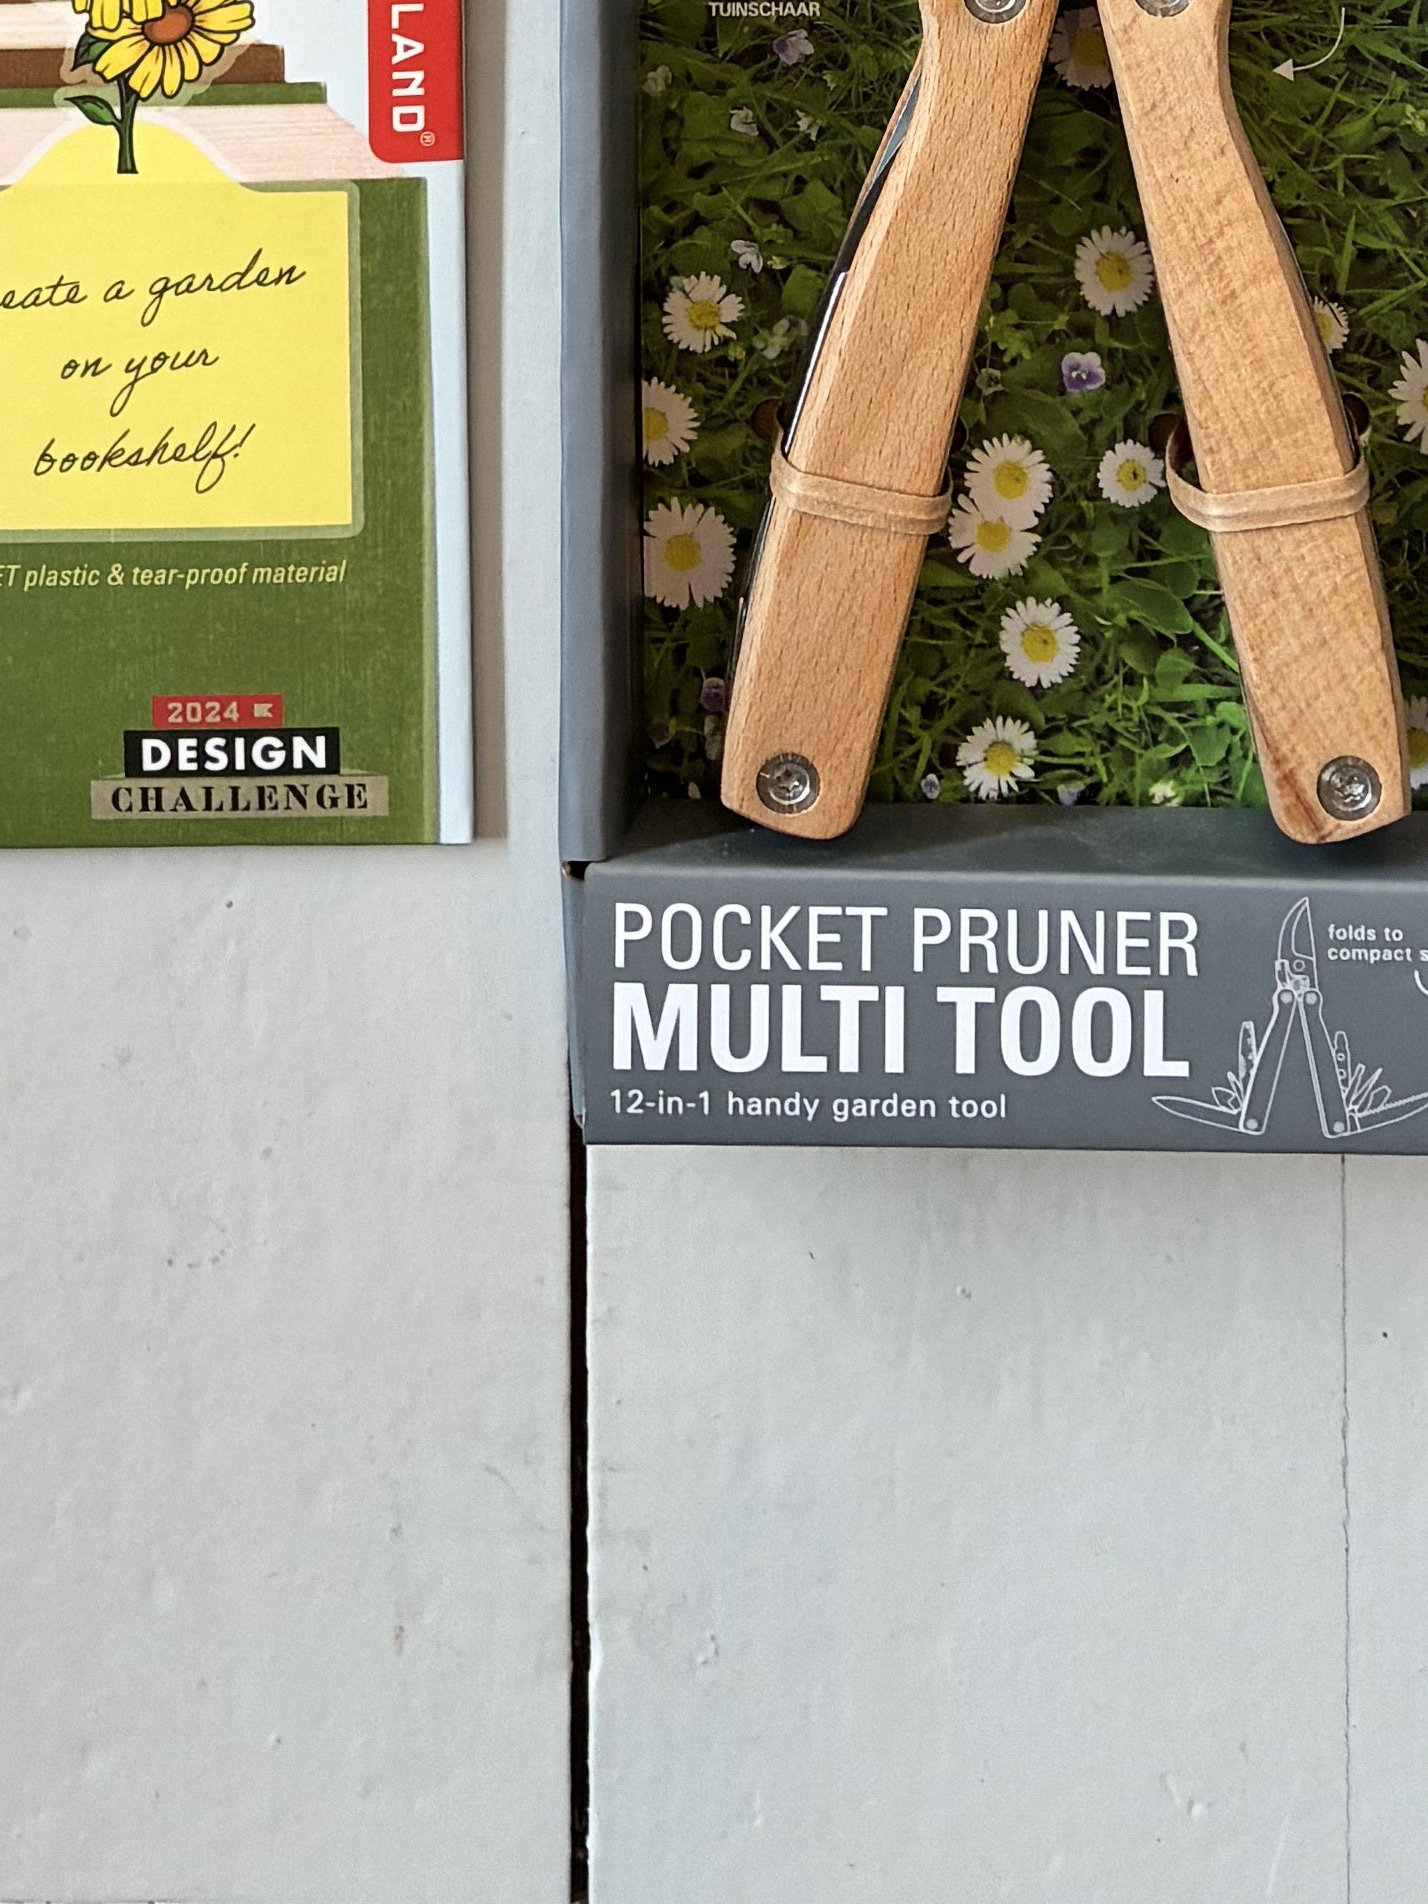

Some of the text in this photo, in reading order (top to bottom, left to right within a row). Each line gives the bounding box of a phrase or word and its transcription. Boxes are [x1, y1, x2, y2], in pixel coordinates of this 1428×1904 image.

[104, 280, 134, 302] a
[138, 248, 307, 327] garden
[60, 347, 219, 417] on your
[34, 423, 256, 495] bookshelf!
[24, 565, 99, 591] plastic
[107, 563, 124, 585] &
[133, 563, 248, 589] tear-proof
[253, 560, 346, 583] material
[168, 702, 240, 723] 2024
[142, 735, 326, 771] DESIGN
[111, 783, 368, 813] CHALLENGE
[615, 903, 1197, 976] POCKET PRUNER
[1328, 924, 1403, 941] folds to
[1328, 948, 1412, 963] compact
[614, 982, 1190, 1077] MULTI TOOL
[611, 1089, 1005, 1122] 12-in-1 handy garden tool
